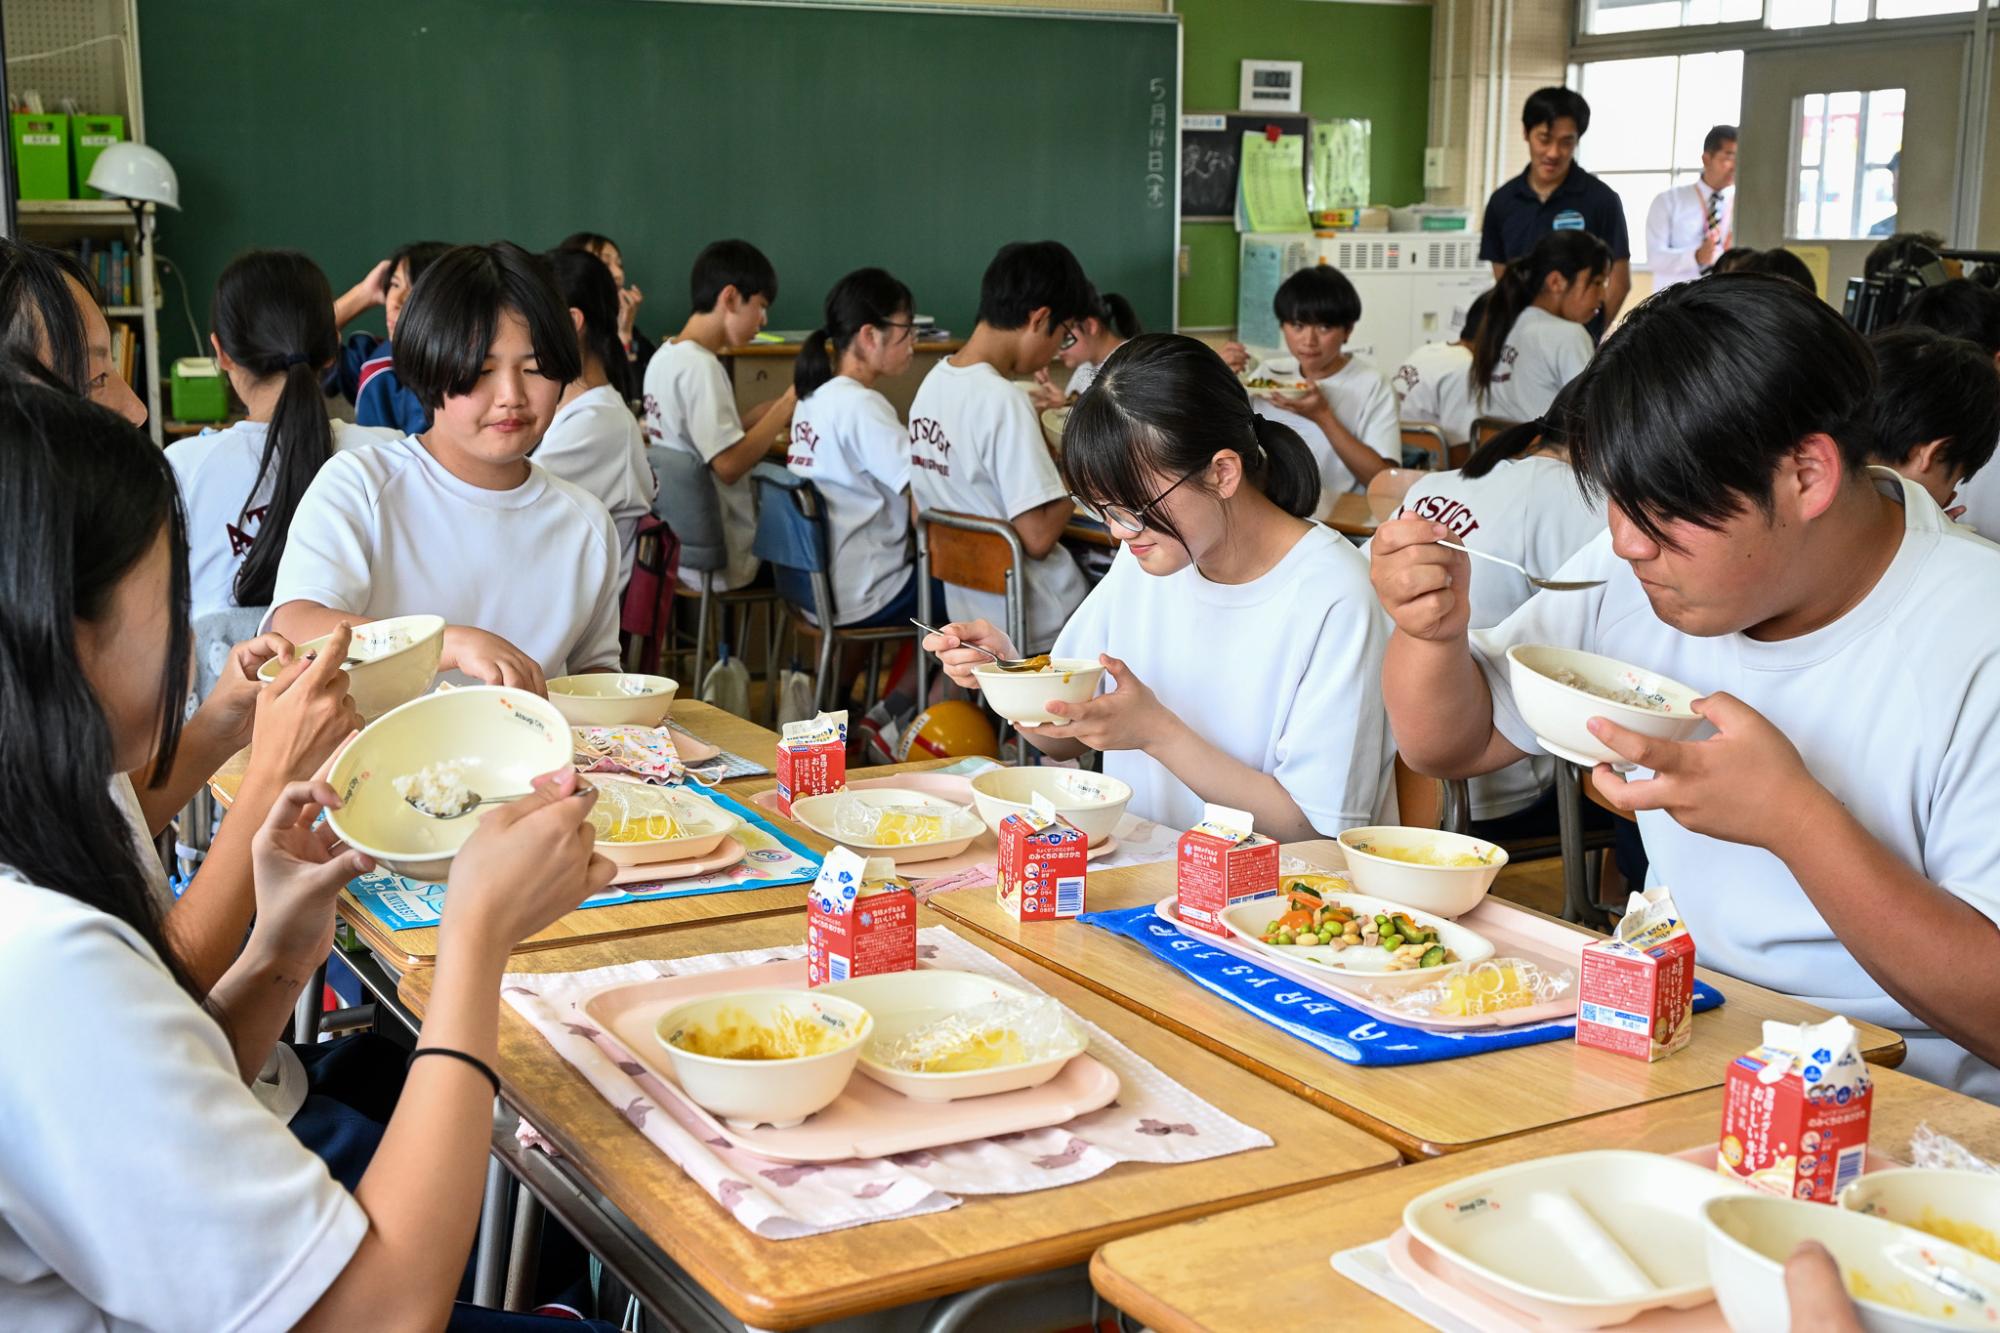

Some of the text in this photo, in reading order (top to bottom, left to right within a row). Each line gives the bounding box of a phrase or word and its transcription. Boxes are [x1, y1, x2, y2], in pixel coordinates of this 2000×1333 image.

[909, 416, 951, 459] TSUGI
[1397, 496, 1480, 538] TSUGI
[811, 757, 820, 796] おいしい牛
